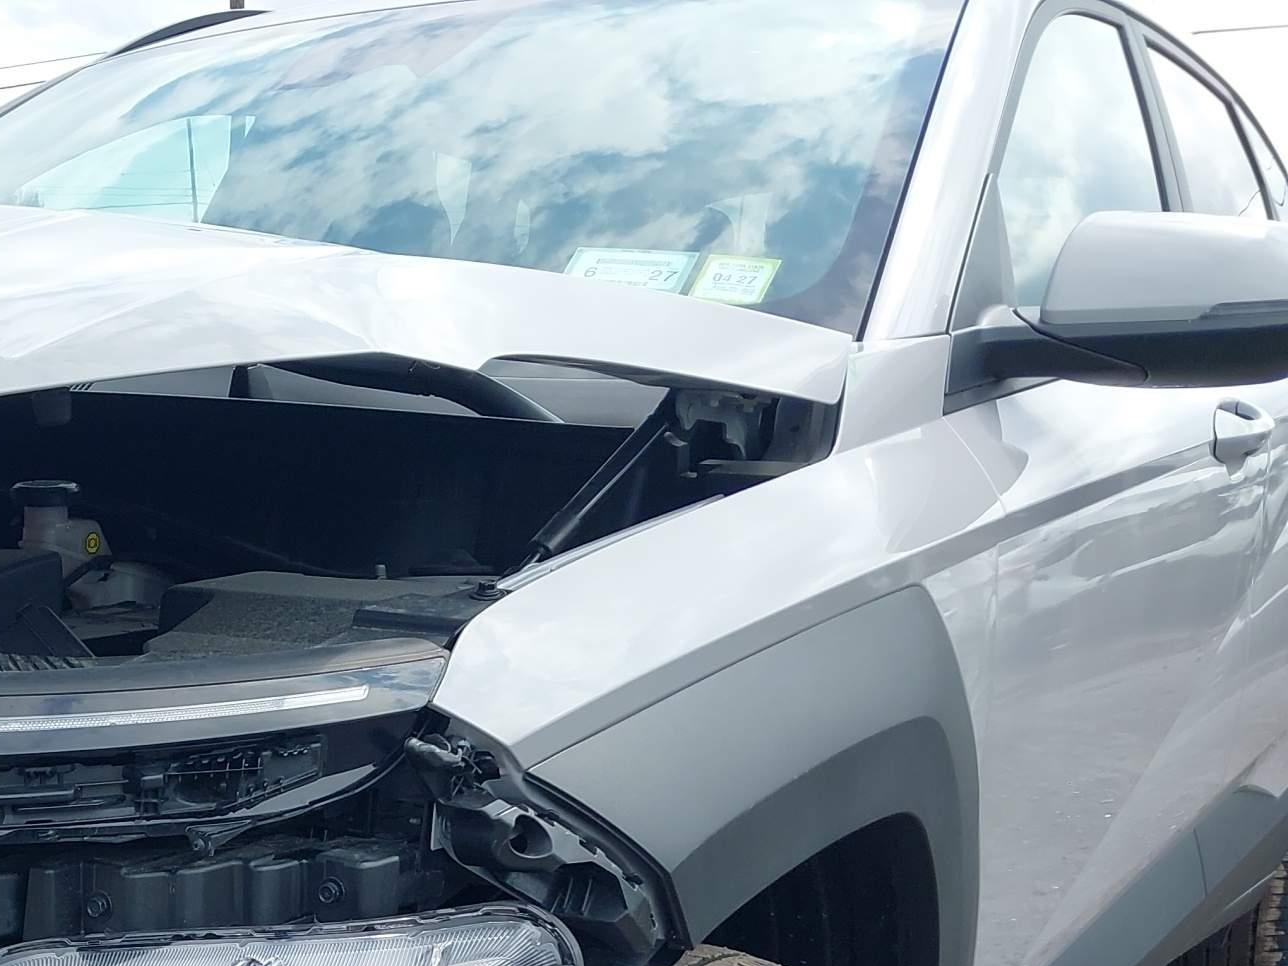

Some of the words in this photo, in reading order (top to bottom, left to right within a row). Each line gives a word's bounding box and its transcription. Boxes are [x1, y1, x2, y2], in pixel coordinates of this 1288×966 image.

[584, 267, 598, 278] 6
[649, 270, 681, 282] 27
[712, 272, 732, 282] 04
[736, 275, 758, 285] 27
